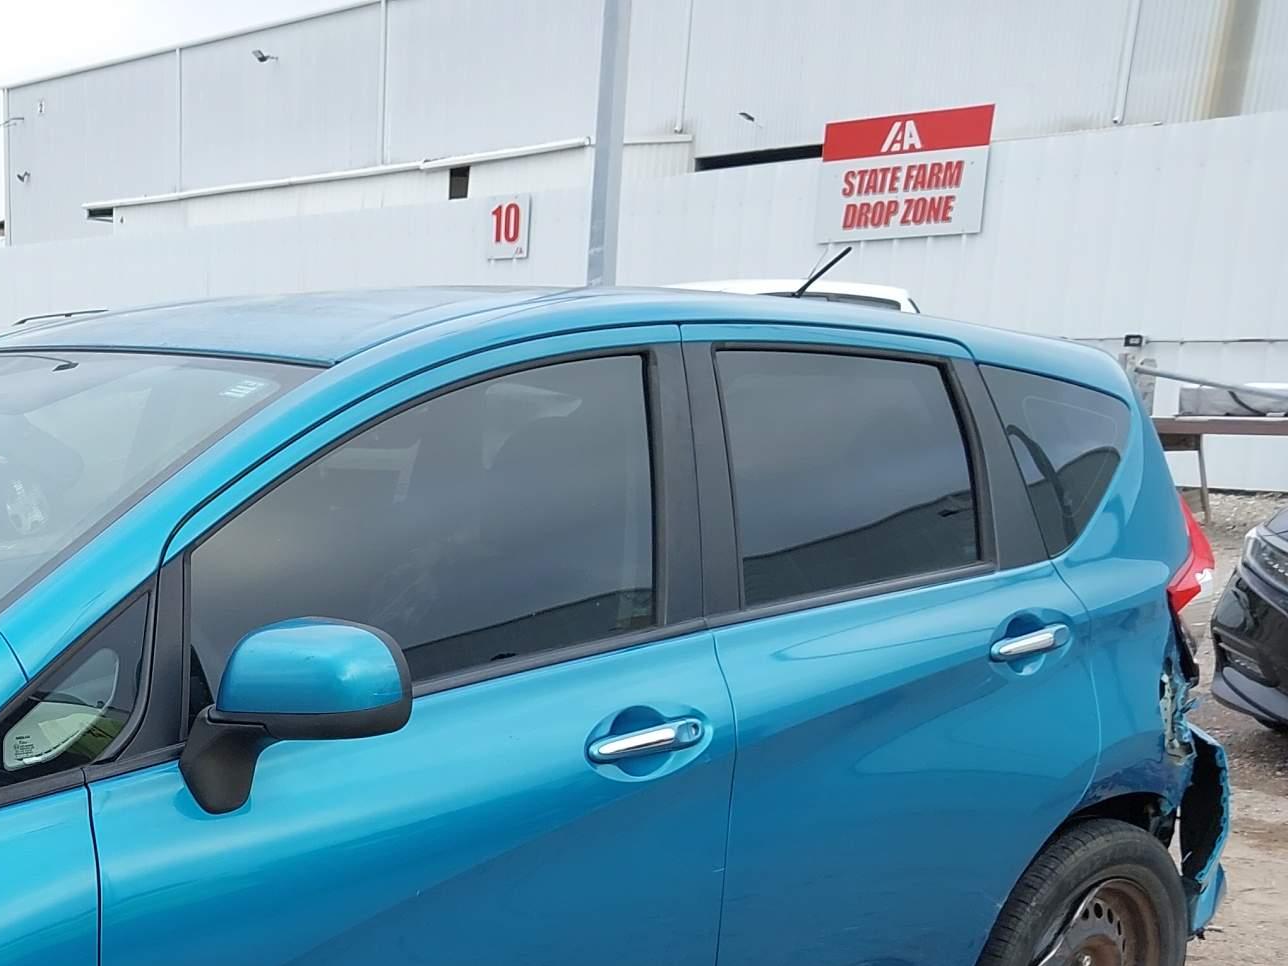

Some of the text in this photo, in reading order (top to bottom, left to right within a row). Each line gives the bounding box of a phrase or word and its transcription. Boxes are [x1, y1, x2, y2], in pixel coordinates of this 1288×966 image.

[842, 160, 965, 198] STATE FARM
[492, 203, 520, 243] 10
[842, 194, 957, 231] DROP ZONE
